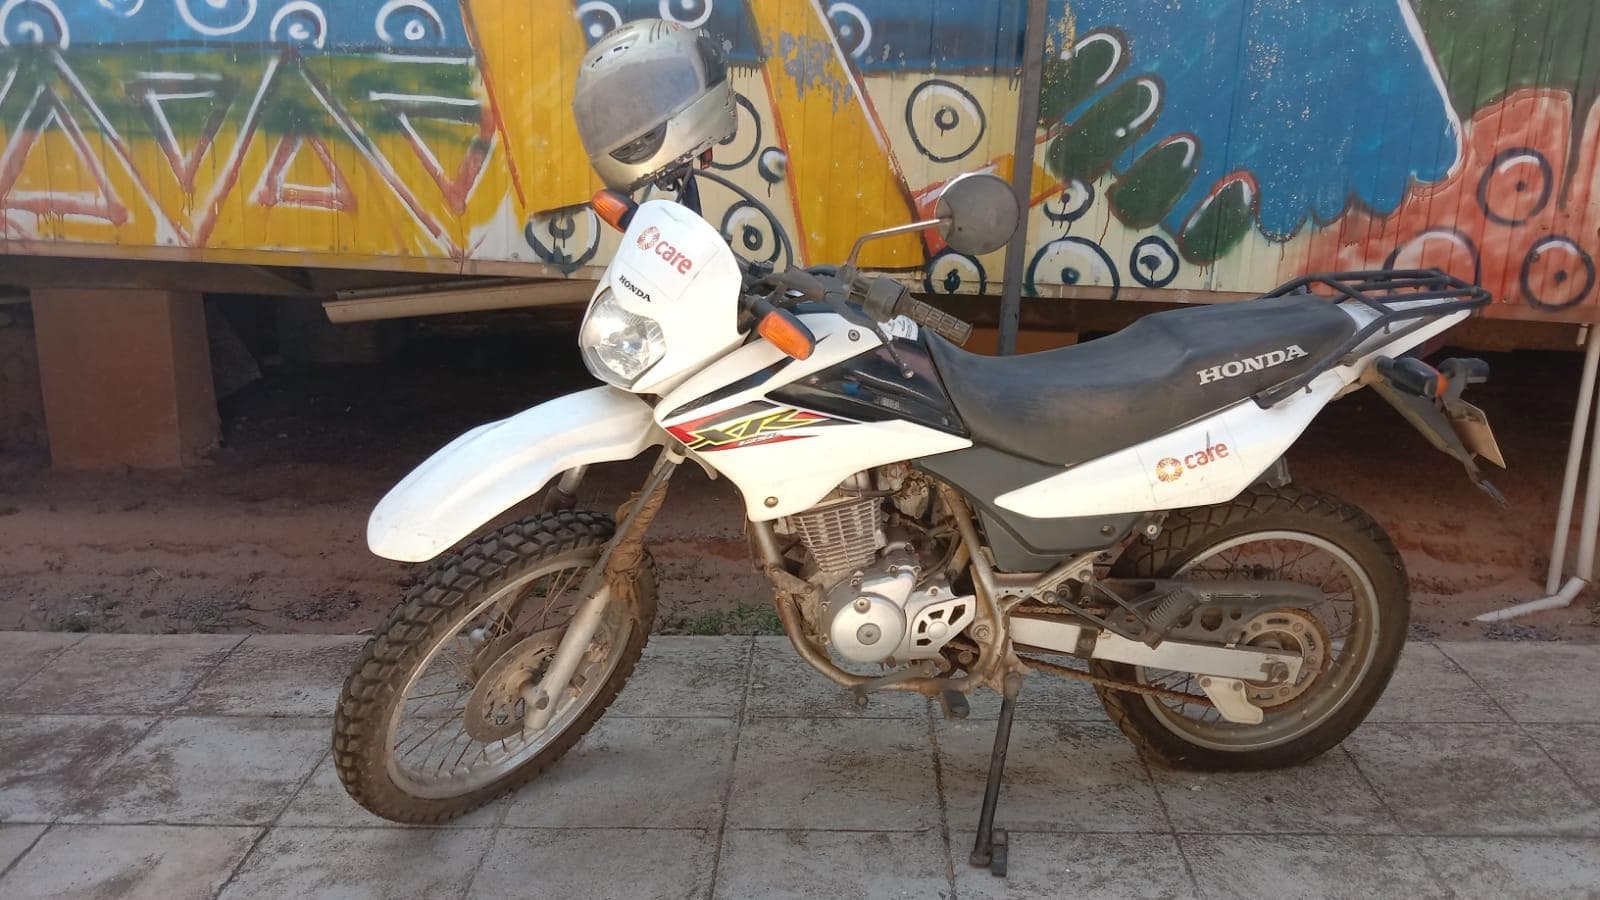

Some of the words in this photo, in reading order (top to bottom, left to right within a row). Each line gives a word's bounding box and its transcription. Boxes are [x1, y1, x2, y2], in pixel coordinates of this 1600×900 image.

[655, 241, 692, 275] care
[619, 275, 651, 302] HONDA
[1196, 344, 1308, 385] HONDA
[1184, 442, 1229, 469] care
